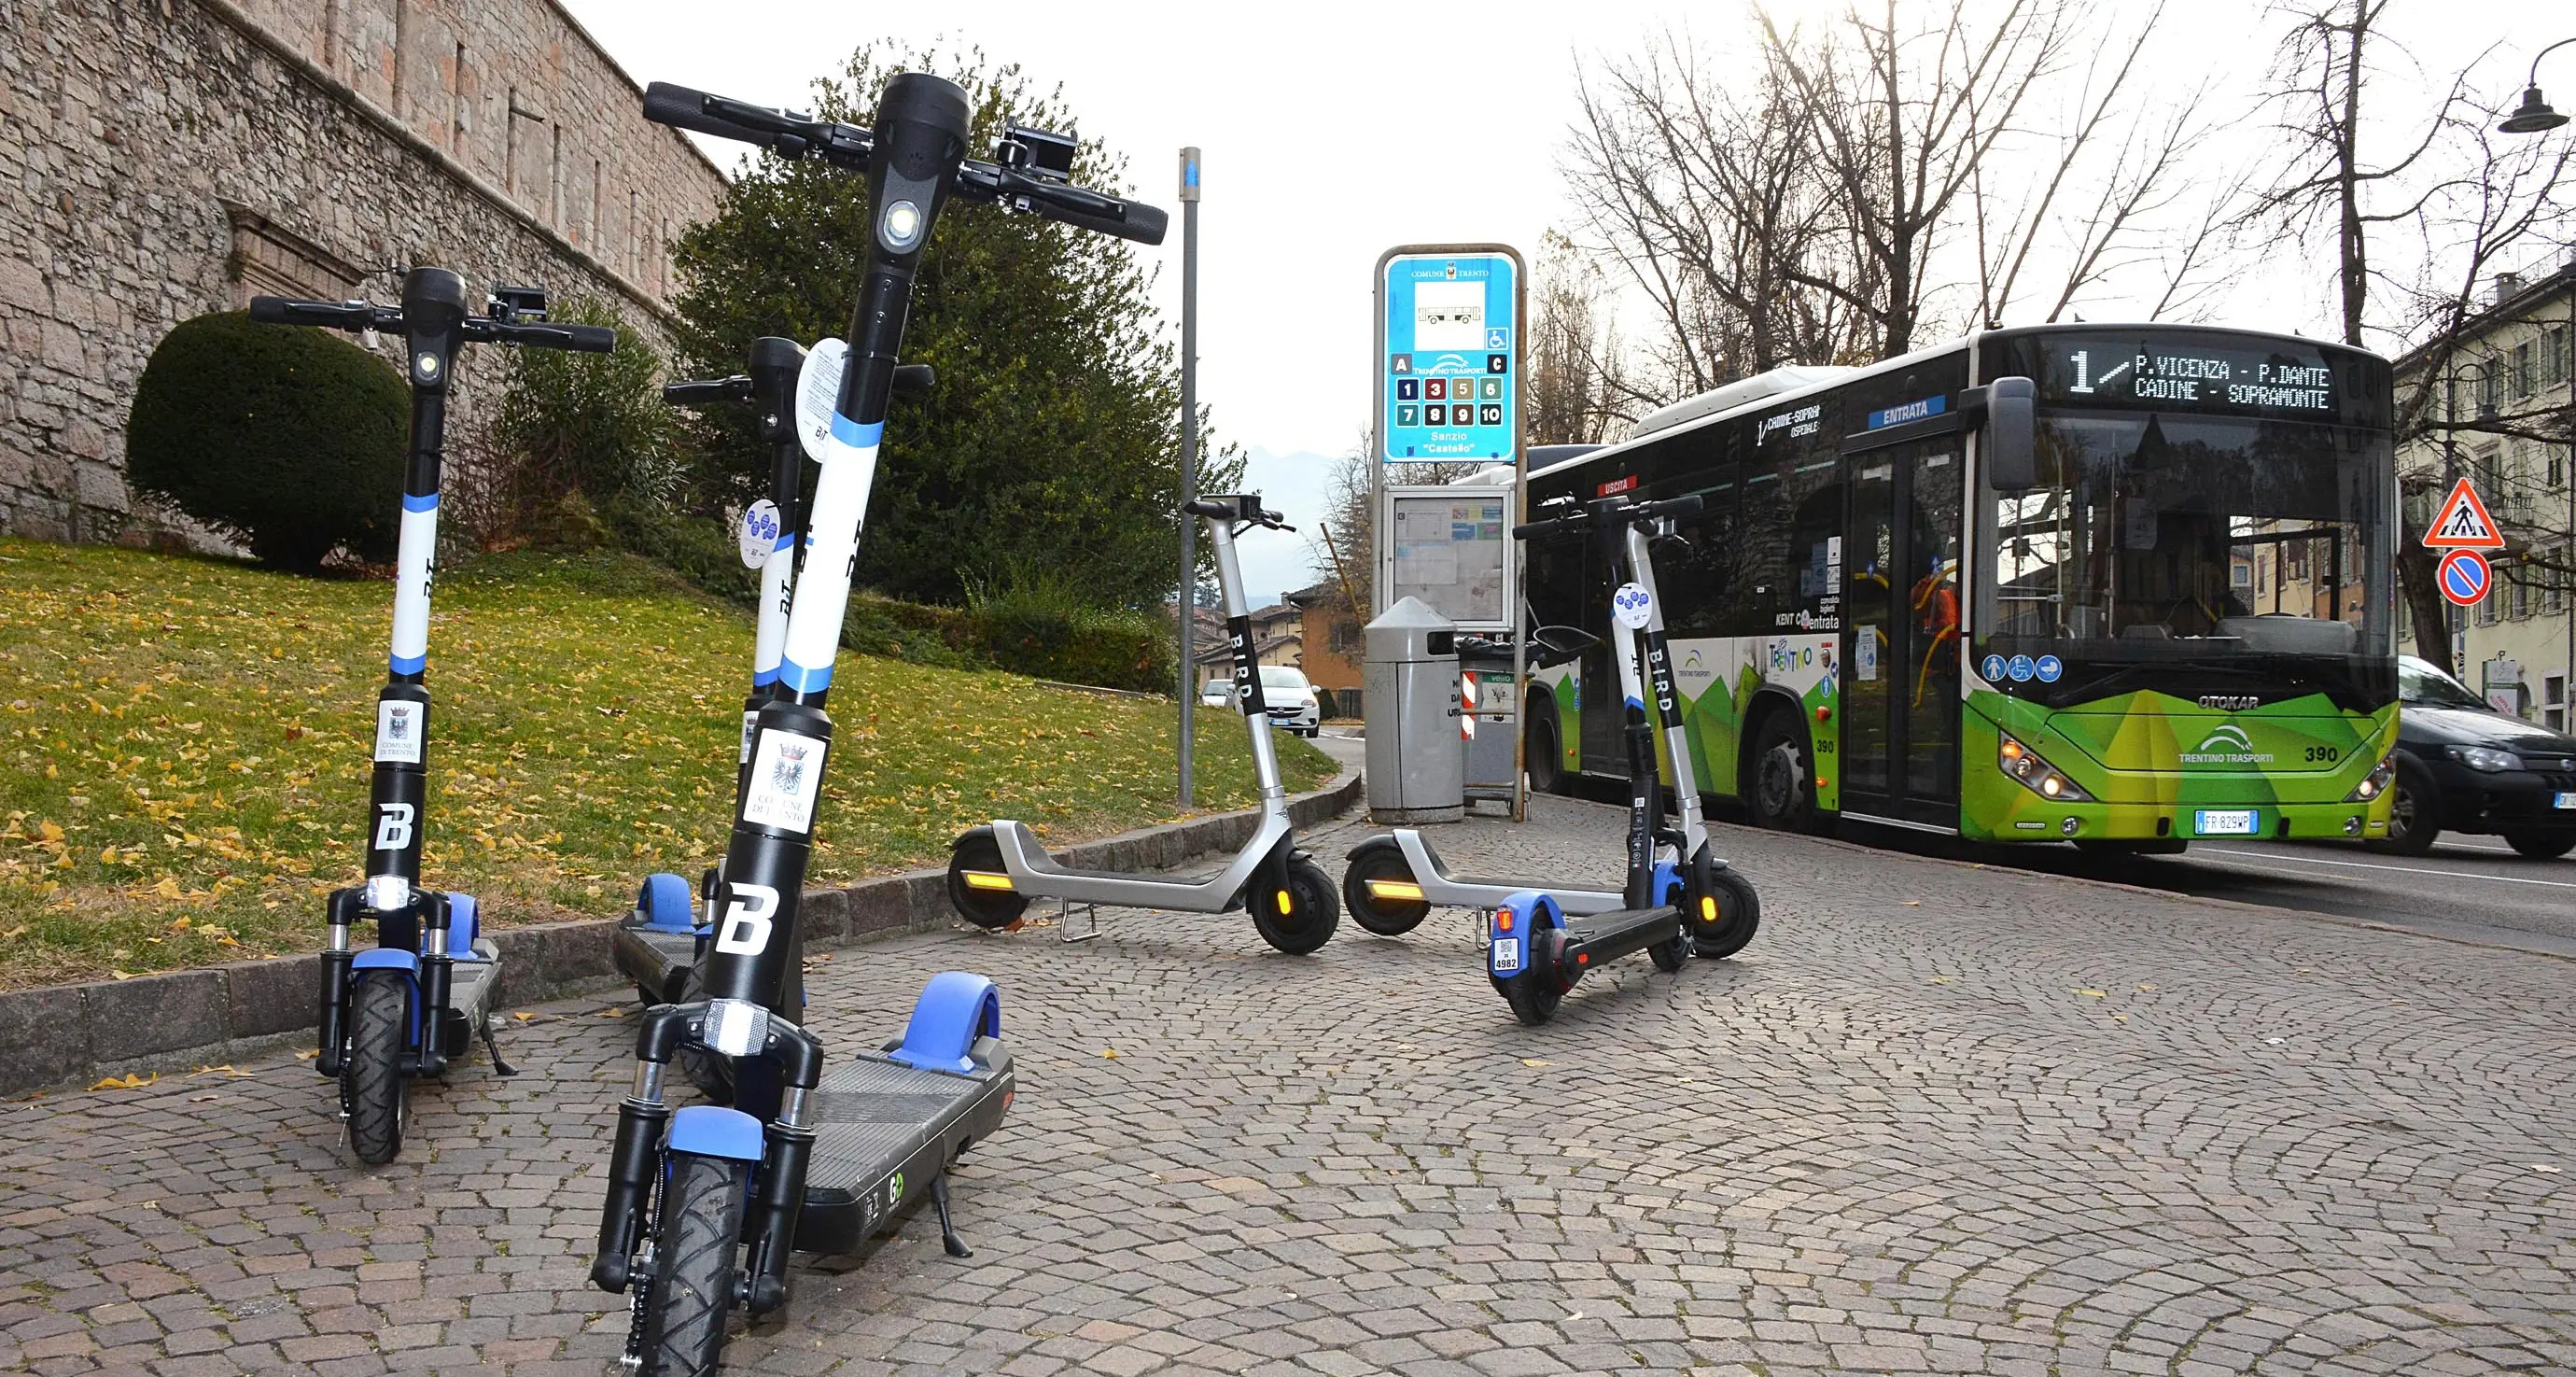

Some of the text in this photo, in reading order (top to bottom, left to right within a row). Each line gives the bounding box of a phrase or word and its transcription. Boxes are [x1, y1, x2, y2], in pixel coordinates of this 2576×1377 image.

[1395, 358, 1407, 372] A
[1492, 358, 1502, 371] C
[2135, 355, 2230, 379] P.VICENZA
[2259, 364, 2330, 386] P.DANTE
[1404, 383, 1495, 396] 1 3 5 6
[2135, 377, 2199, 400] CADINE
[2228, 385, 2330, 409] SOPRAMONTE
[1404, 408, 1500, 422] 7 8 9 10
[1883, 400, 1928, 425] ENTRATA
[1431, 431, 1467, 441] Sanzio
[1605, 478, 1628, 495] USCITA
[1775, 612, 1795, 626] KENT
[1809, 614, 1840, 630] entrata
[1231, 633, 1253, 698] BIRD
[1649, 648, 1673, 711] BIRD
[2198, 696, 2259, 710] OTOKAR
[1817, 739, 1834, 753] 390
[2304, 746, 2338, 763] 390
[2178, 753, 2274, 763] TRENTINO TRASPORTI
[375, 802, 414, 851] B
[715, 881, 780, 956] B
[1496, 958, 1517, 969] 4982
